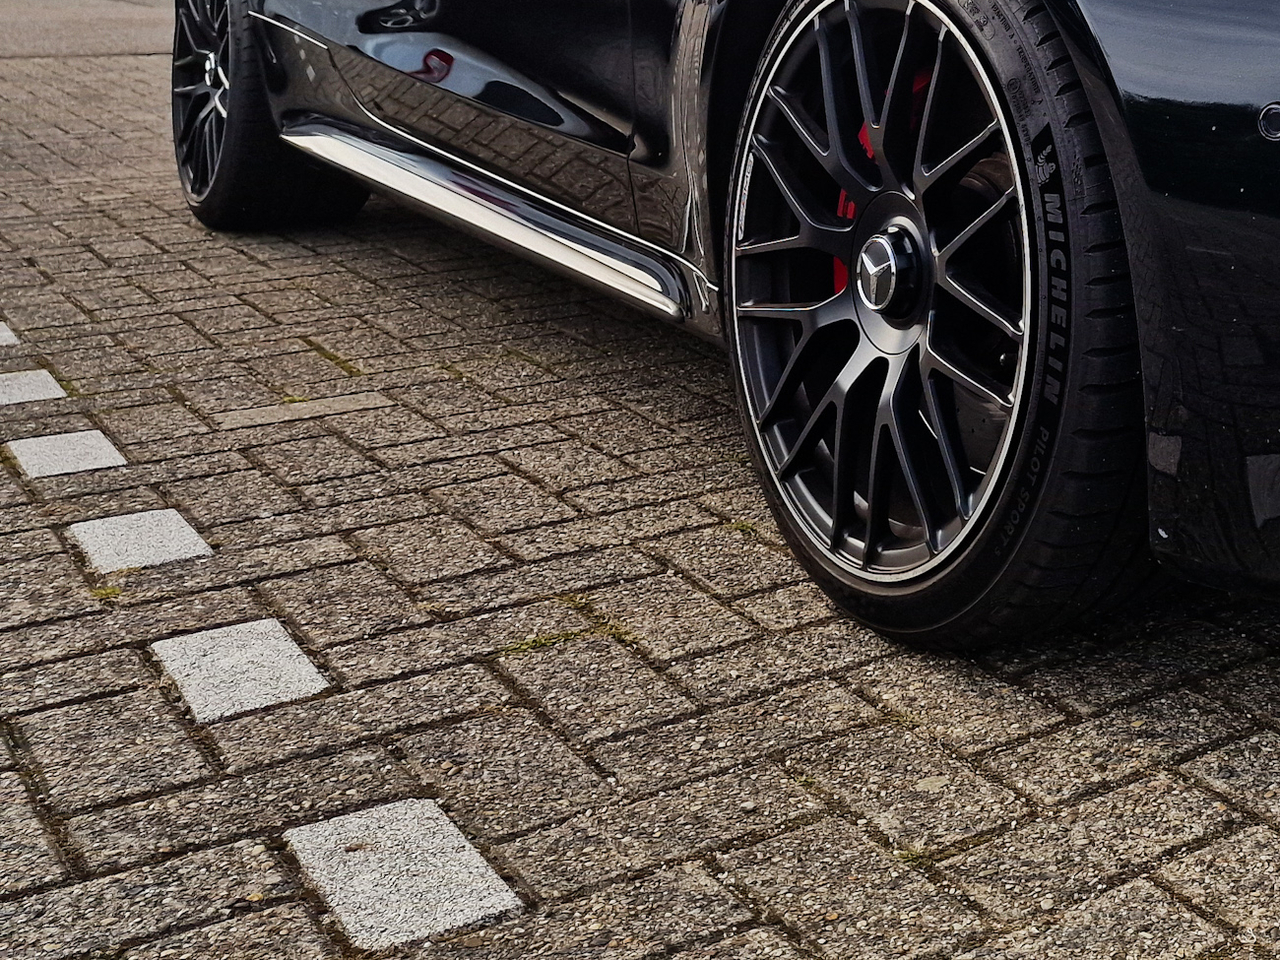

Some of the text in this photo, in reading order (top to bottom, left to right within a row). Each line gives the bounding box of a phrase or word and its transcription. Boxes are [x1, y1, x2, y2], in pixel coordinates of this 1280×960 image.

[1043, 192, 1069, 406] MICHELIN
[1026, 425, 1050, 487] PILOT
[1003, 487, 1030, 547] SPORT
